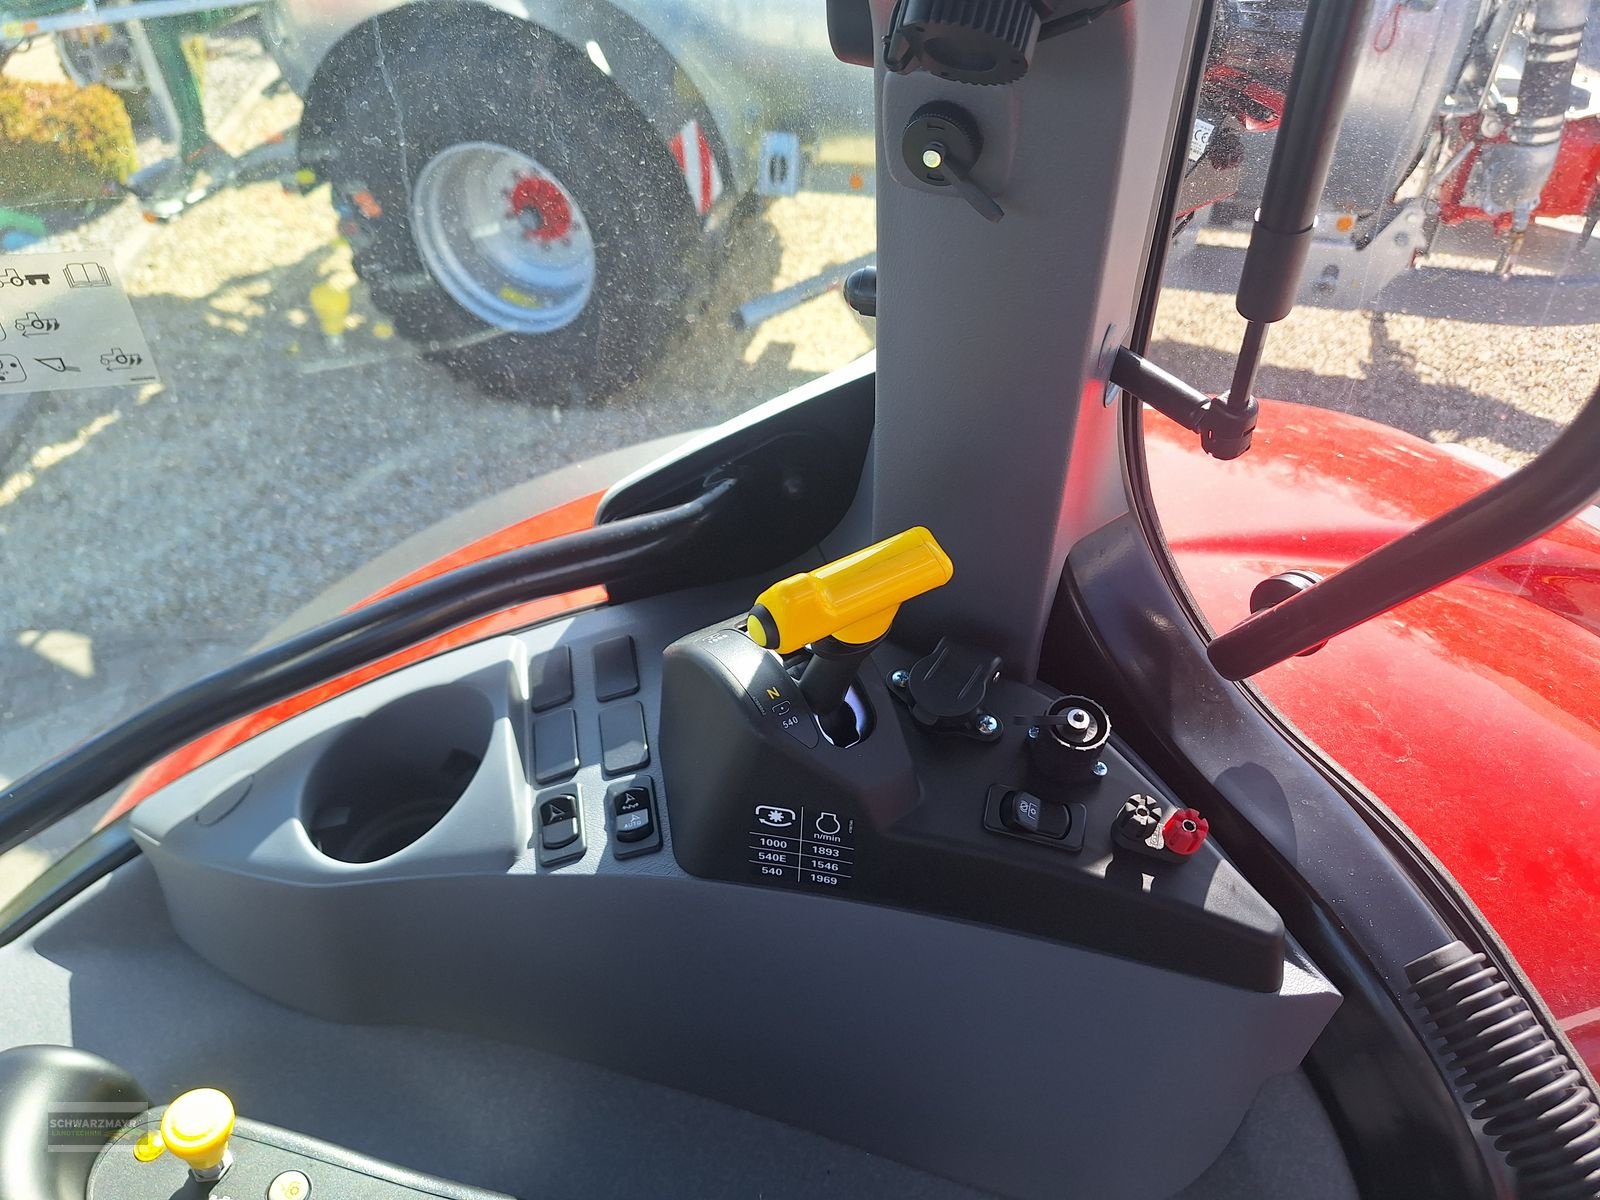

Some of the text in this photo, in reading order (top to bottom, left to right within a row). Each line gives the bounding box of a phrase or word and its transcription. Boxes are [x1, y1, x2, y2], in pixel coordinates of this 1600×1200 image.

[766, 686, 781, 700] N
[782, 716, 799, 729] 540
[624, 821, 642, 829] AUTO
[759, 837, 788, 849] 1000
[813, 833, 841, 843] n/min
[812, 845, 840, 857] 1893
[758, 852, 787, 863] 540E
[761, 866, 783, 876] 540
[811, 859, 839, 871] 1546
[810, 873, 838, 885] 1969
